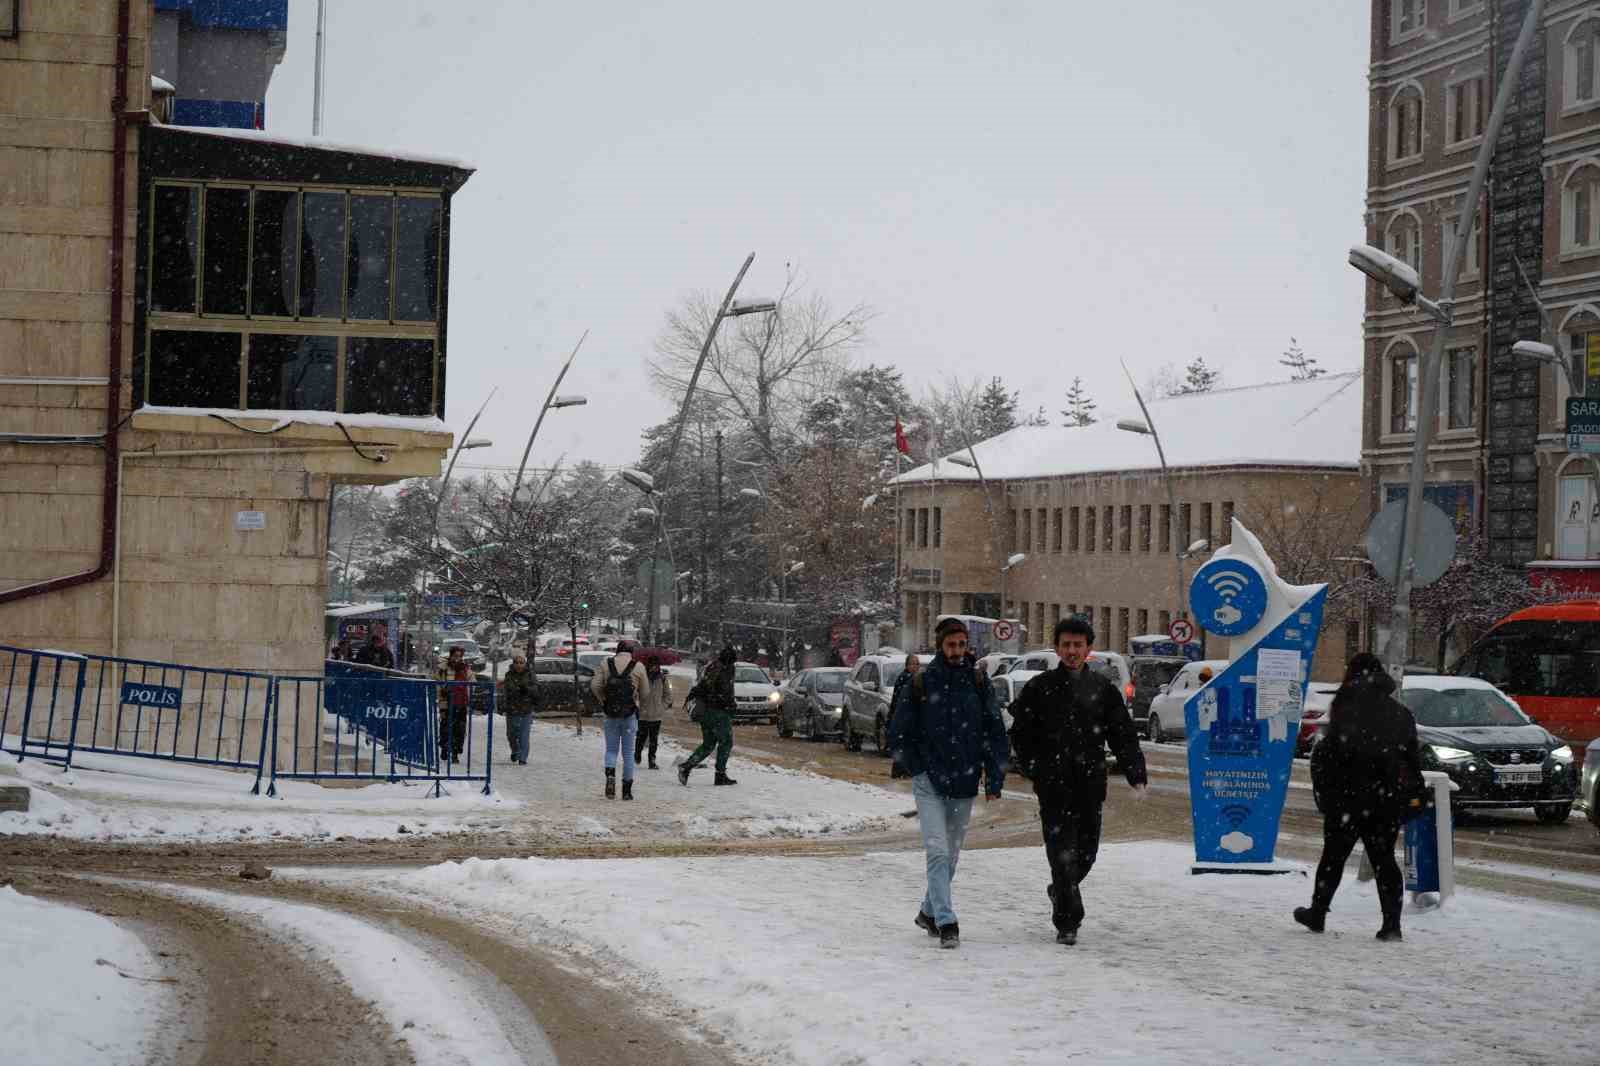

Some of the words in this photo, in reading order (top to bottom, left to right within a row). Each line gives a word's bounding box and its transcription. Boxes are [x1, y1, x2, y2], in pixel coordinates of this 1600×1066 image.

[1570, 401, 1600, 416] SAR
[1570, 424, 1600, 433] CADD
[128, 688, 177, 704] POLİS
[366, 704, 409, 719] POLİS
